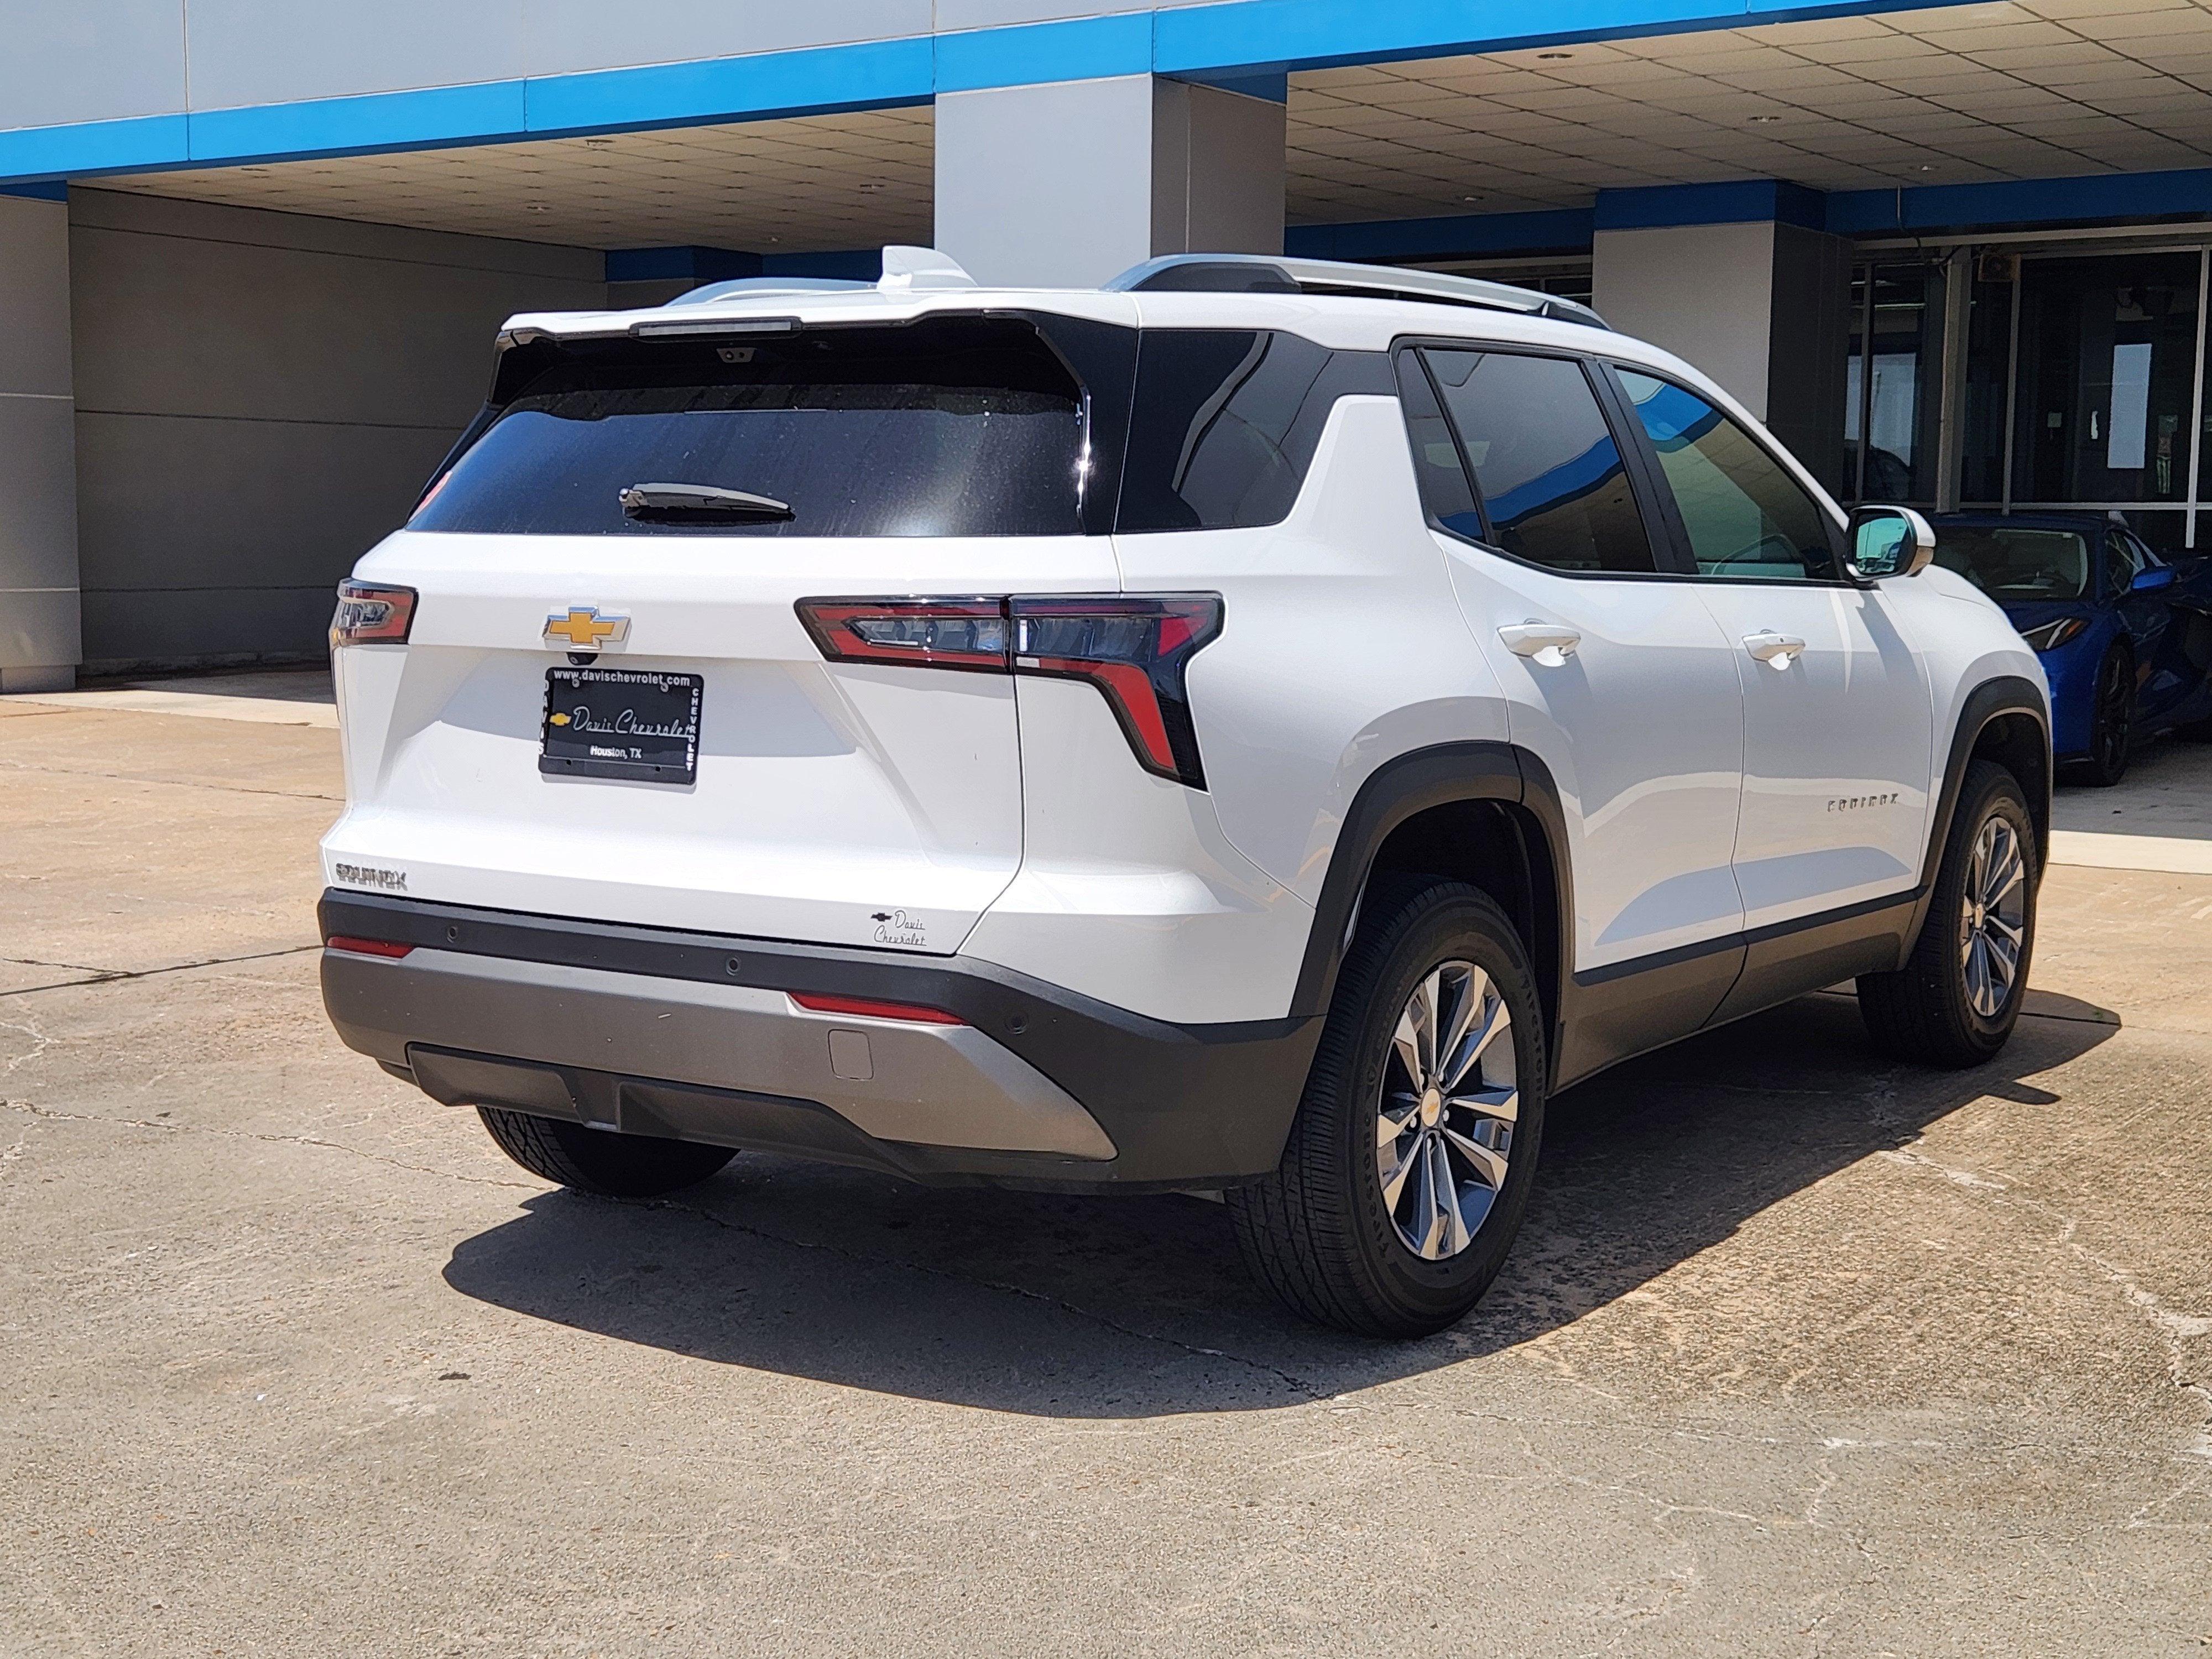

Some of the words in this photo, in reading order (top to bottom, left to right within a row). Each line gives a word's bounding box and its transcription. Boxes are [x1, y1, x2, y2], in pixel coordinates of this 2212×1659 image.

[554, 670, 690, 687] www.davischevrolet.com
[573, 706, 615, 733] Davis
[686, 687, 700, 771] CHEVROLET
[590, 745, 628, 759] Houston,
[630, 748, 642, 759] TX
[894, 910, 926, 931] Davis
[874, 925, 927, 946] Chevrolet
